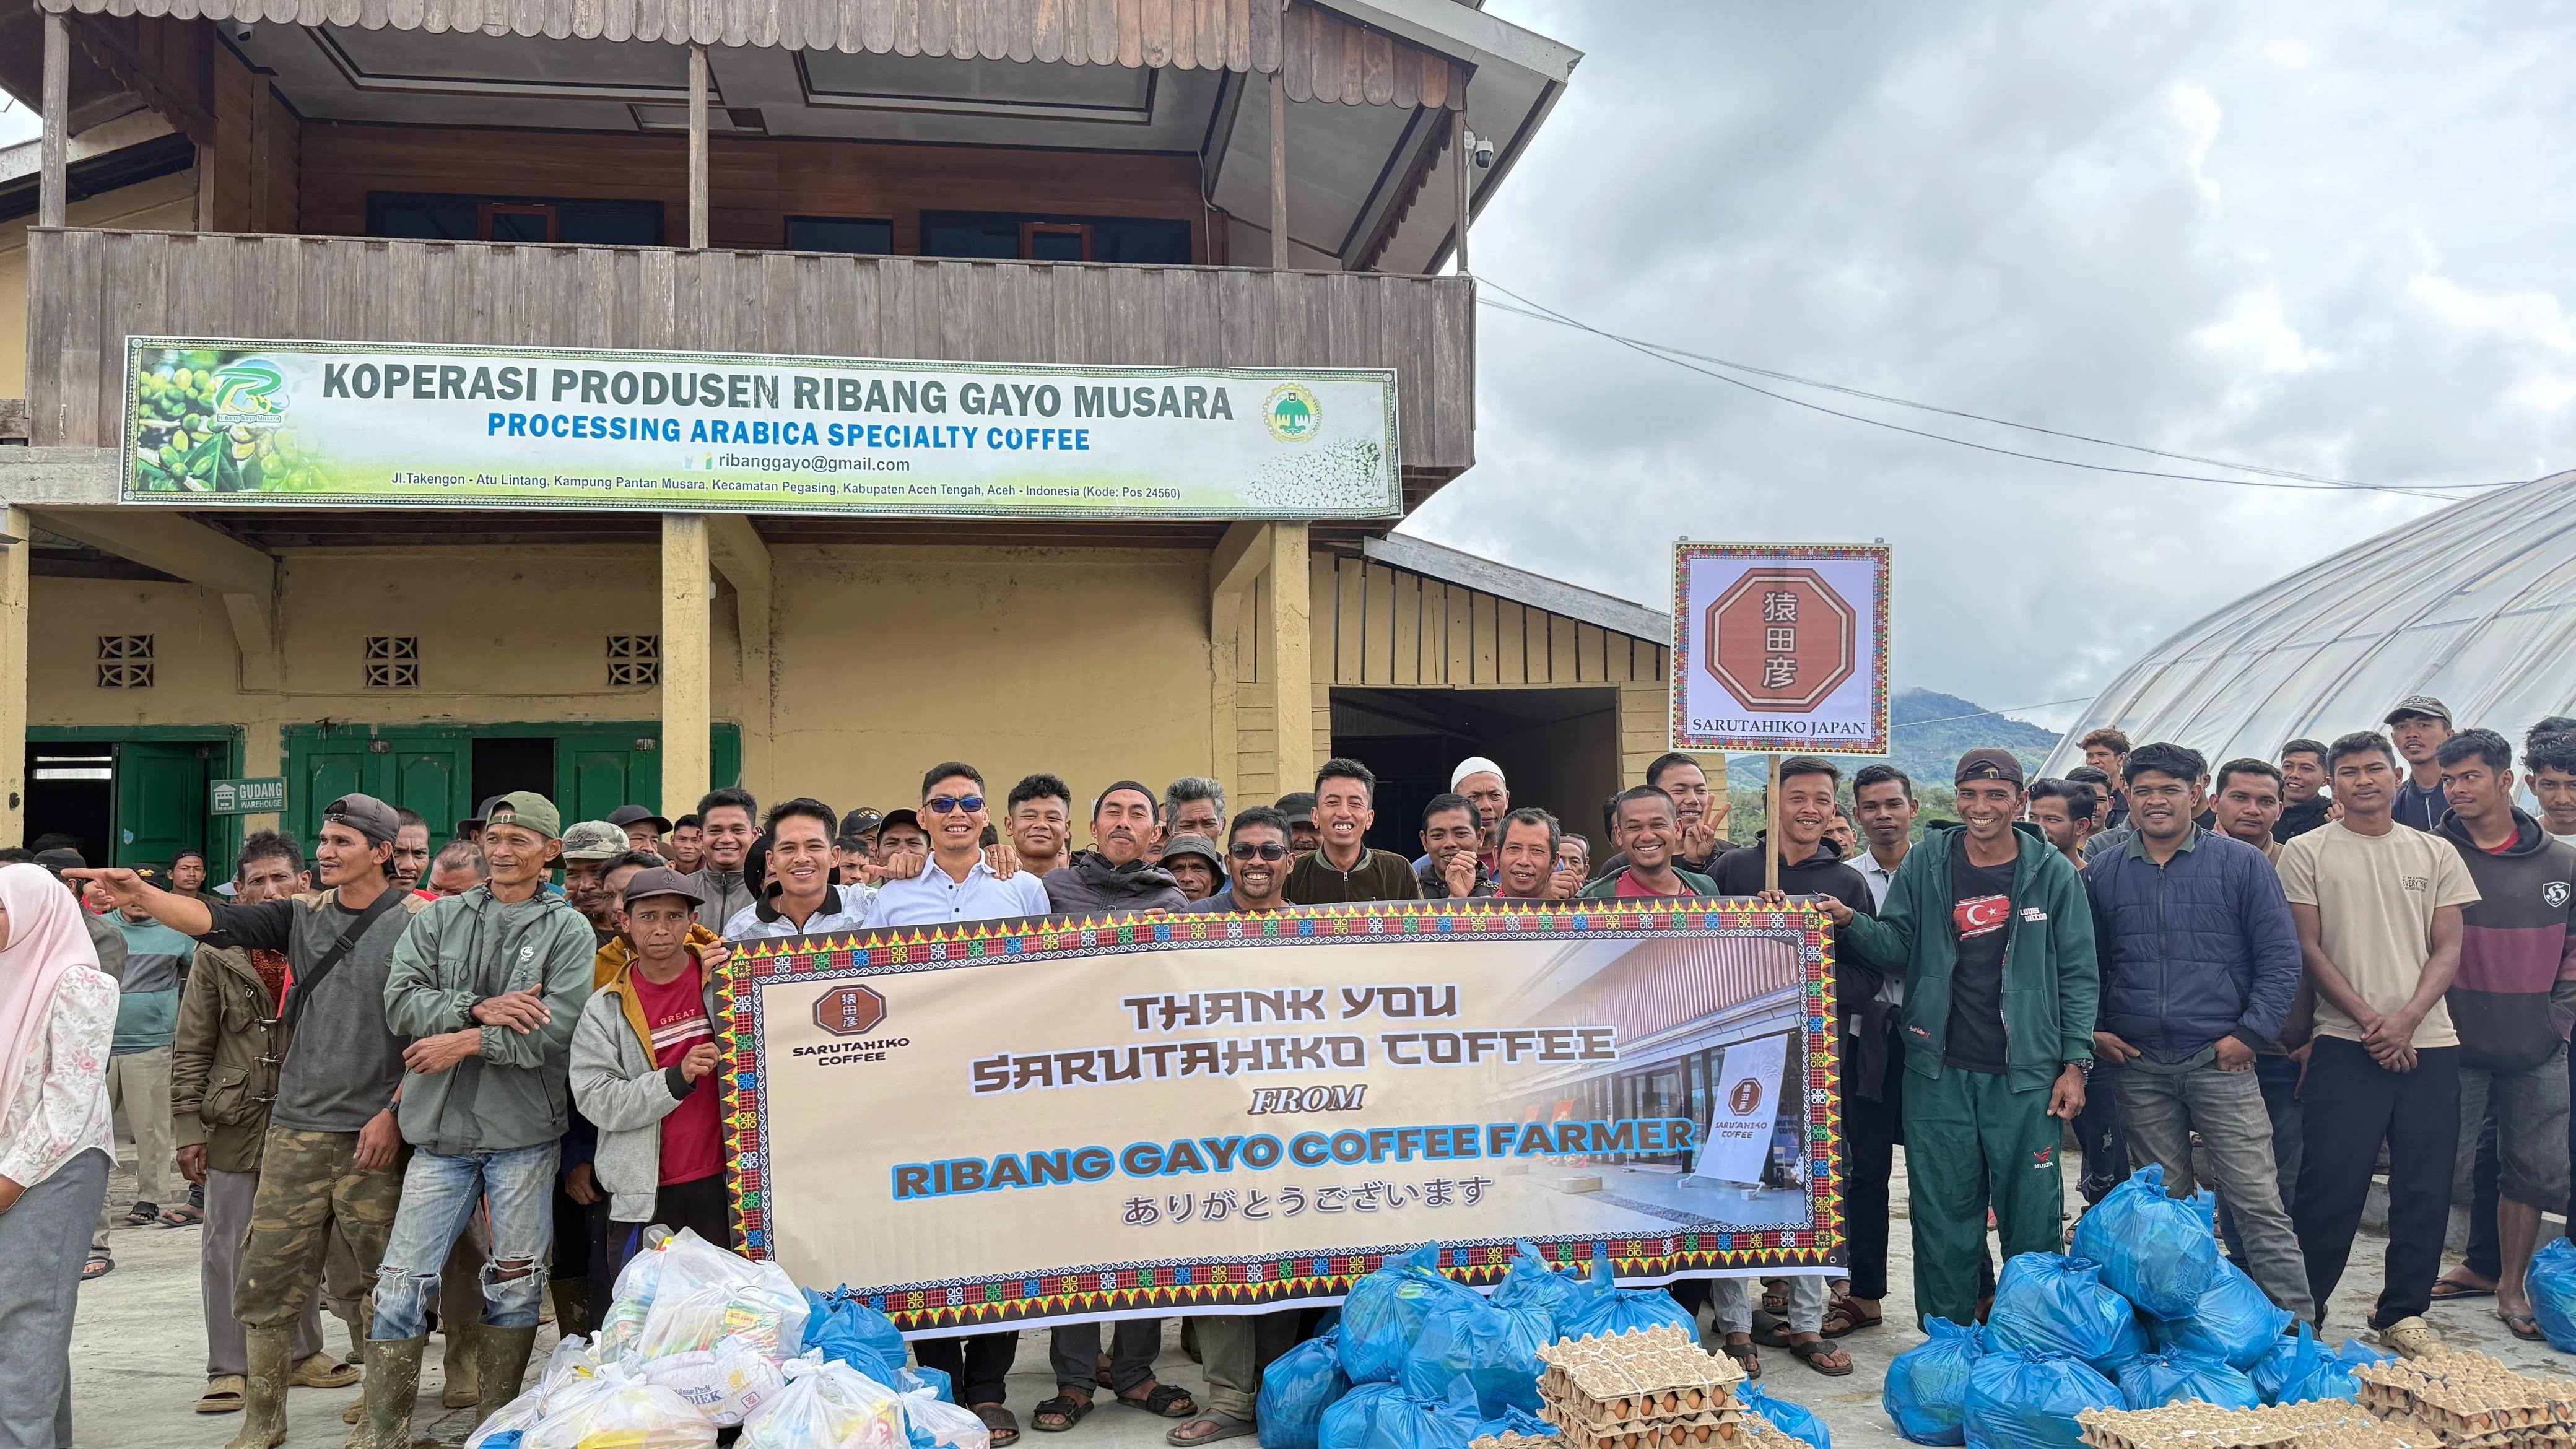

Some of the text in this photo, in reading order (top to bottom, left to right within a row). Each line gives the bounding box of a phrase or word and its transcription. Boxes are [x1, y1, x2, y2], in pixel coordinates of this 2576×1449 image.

[323, 363, 1234, 422] KOPERASI PRODUSEN RIBANG GAYO MUSARA
[488, 413, 1090, 451] PROCESSING ARABICA SPECIALTY COFFEE
[718, 453, 910, 473] ribanggayo@gmail.com
[392, 472, 465, 485] Jl.Takengon
[476, 474, 497, 485] Atu
[502, 474, 550, 488] Lintang,
[554, 476, 612, 490] Kampung
[616, 477, 658, 489] Pantan
[662, 478, 708, 491] Musara,
[713, 479, 778, 492] Kecamatan
[783, 481, 840, 496] Pegasing,
[843, 482, 904, 497] Kabupaten
[908, 484, 936, 495] Aceh
[939, 484, 984, 498] Tengah,
[988, 485, 1016, 496] Aceh
[1026, 486, 1079, 497] Indonesia
[1082, 486, 1119, 500] (Kode:
[1122, 488, 1142, 498] Pos
[1146, 487, 1180, 500] 24560)
[1762, 591, 1798, 688] 猿田彦
[1692, 718, 1865, 736] SARUTAHIKO JAPAN
[240, 782, 283, 799] GUDANG
[241, 799, 282, 809] WAREHOUSE
[659, 1008, 695, 1025] GREAT
[842, 993, 859, 1028] 猿田彦
[1121, 983, 1460, 1032] THANK YOU
[793, 1038, 910, 1057] SARUTAHIKO
[818, 1051, 886, 1066] COFFEE
[970, 1025, 1621, 1095] SARUTAHIKO COFFEE
[1247, 1083, 1368, 1116] FROM
[1715, 1121, 1767, 1129] SARUTAHIKO
[1721, 1131, 1753, 1139] COFFEE
[892, 1118, 1696, 1201] RIBANG GAYO COFFEE FARMER
[1123, 1175, 1494, 1226] ありがとうございます
